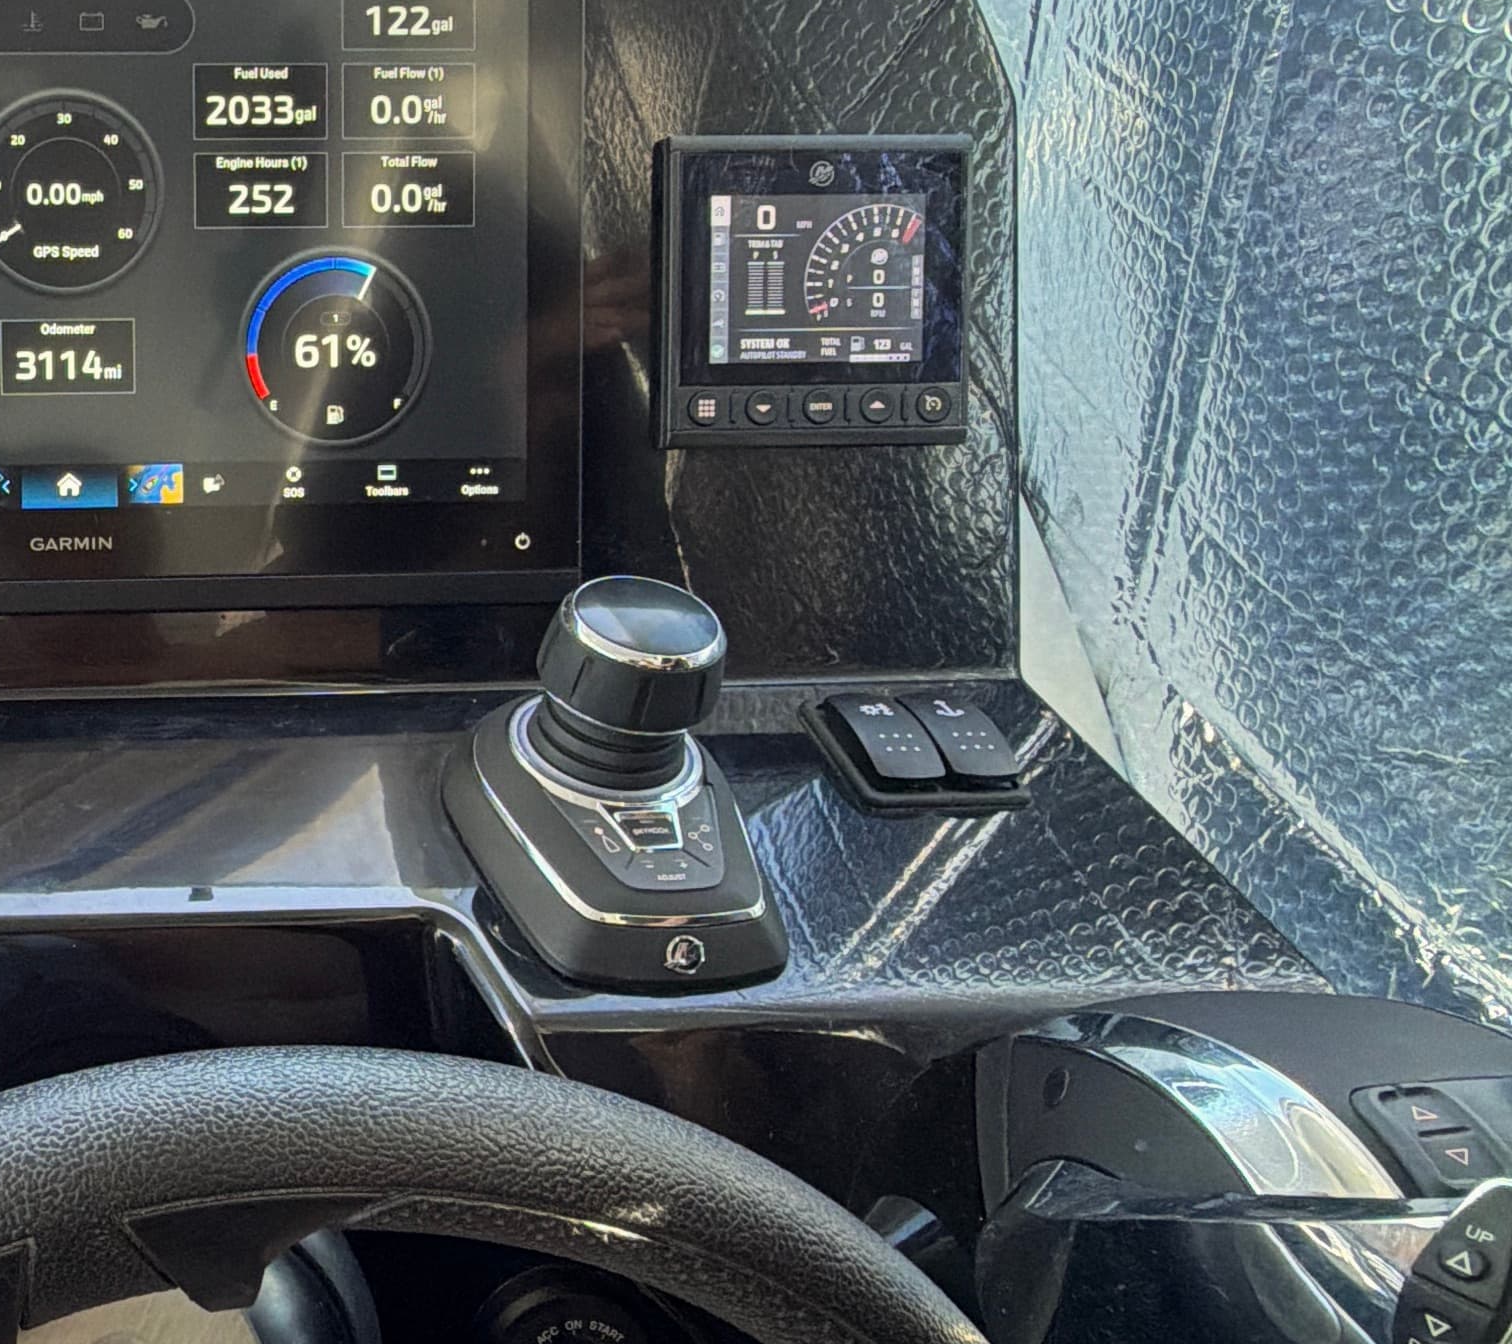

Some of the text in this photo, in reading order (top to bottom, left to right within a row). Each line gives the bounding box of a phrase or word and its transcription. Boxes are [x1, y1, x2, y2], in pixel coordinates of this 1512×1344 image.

[234, 67, 289, 80] Fuel Used
[374, 67, 445, 81] Fuel Flow (1)
[56, 113, 72, 125] 30
[10, 134, 26, 146] 20
[103, 134, 119, 146] 40
[216, 156, 308, 171] Engine Hours (1)
[381, 156, 438, 168] Total Flow
[128, 179, 144, 191] 50
[228, 184, 295, 215] 252
[757, 204, 776, 230] 0
[118, 228, 133, 240] 60
[33, 245, 99, 261] GPS Speed
[873, 269, 885, 284] 0
[872, 292, 885, 308] 0
[40, 323, 96, 336] Odometer
[294, 334, 377, 369] 61%
[269, 399, 278, 411] E
[393, 398, 402, 410] F
[283, 486, 305, 499] SOS
[365, 485, 409, 497] Toolbars
[461, 484, 499, 498] Options
[29, 536, 113, 552] GARMIN
[1465, 1224, 1496, 1243] UP
[564, 1319, 583, 1331] ON
[589, 1320, 625, 1343] START
